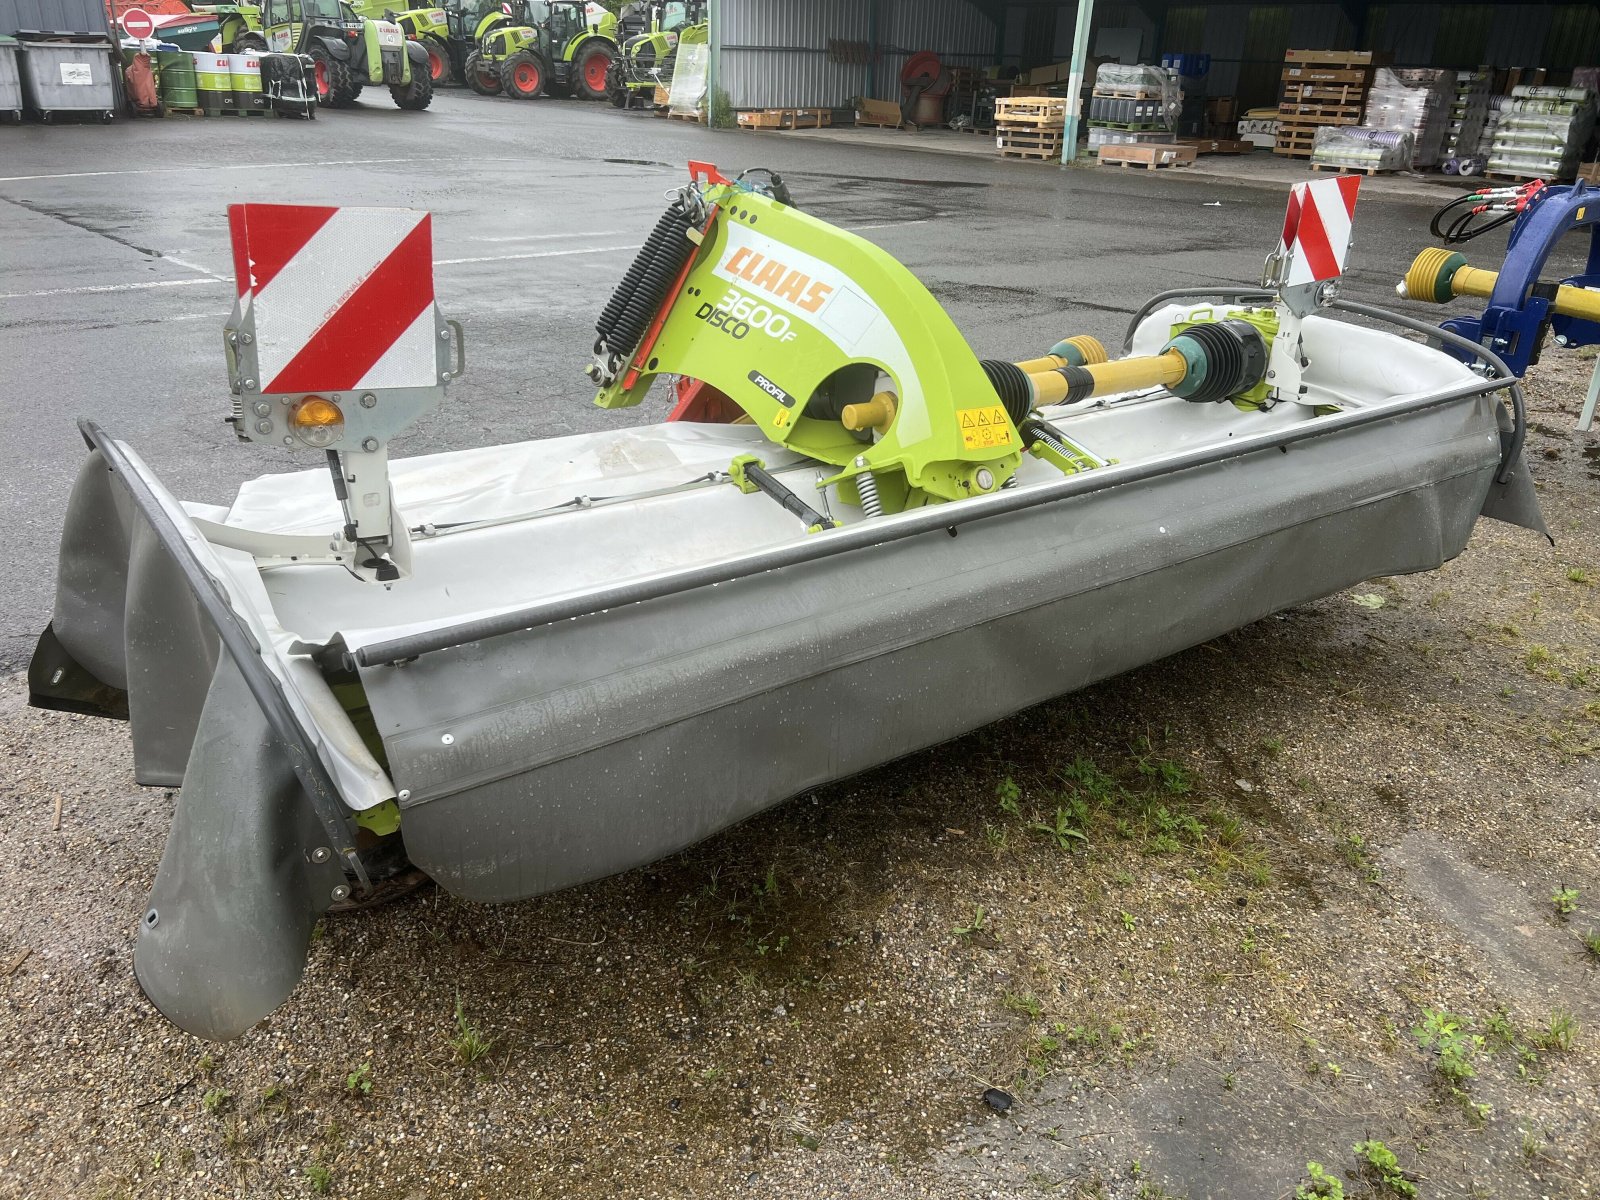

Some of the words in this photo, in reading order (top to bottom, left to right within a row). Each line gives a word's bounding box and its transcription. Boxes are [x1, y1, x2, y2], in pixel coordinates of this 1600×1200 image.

[277, 31, 289, 39] CLAAS
[725, 246, 834, 314] CLAAS
[695, 302, 750, 340] DISCO
[754, 375, 786, 403] PROFIL
